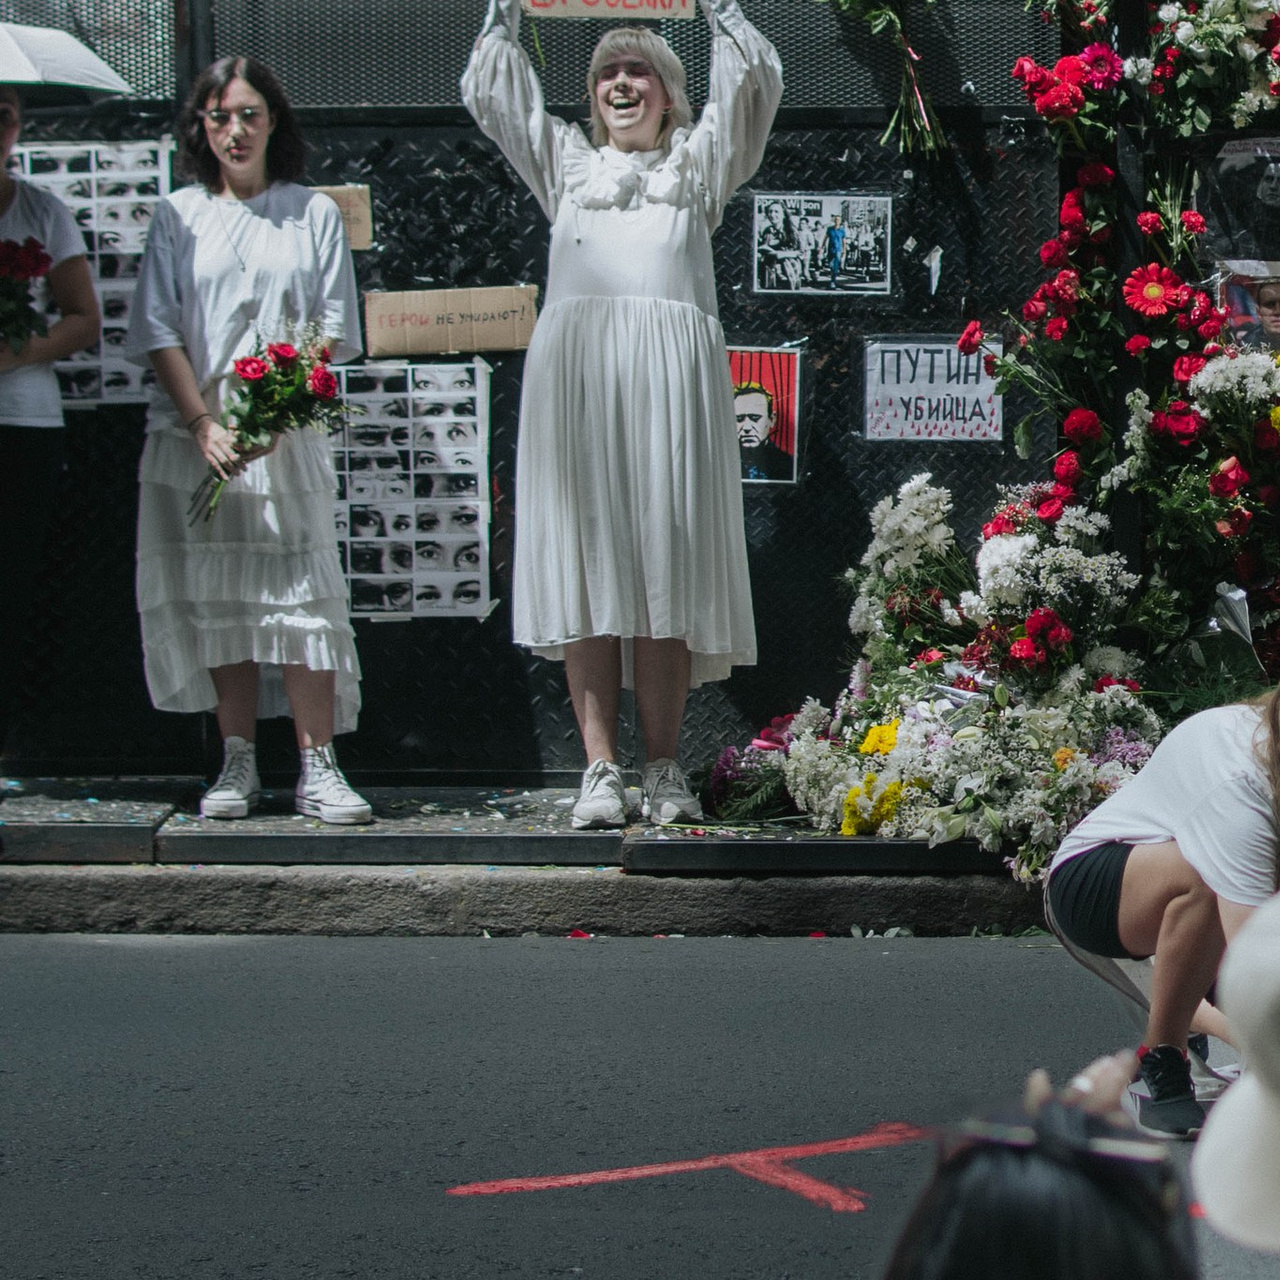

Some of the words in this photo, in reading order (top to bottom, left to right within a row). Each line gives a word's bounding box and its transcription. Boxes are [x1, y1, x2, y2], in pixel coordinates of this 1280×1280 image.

[436, 314, 454, 325] НЕ
[881, 348, 982, 384] ПУТИН
[900, 394, 986, 424] УБИЙЦА
